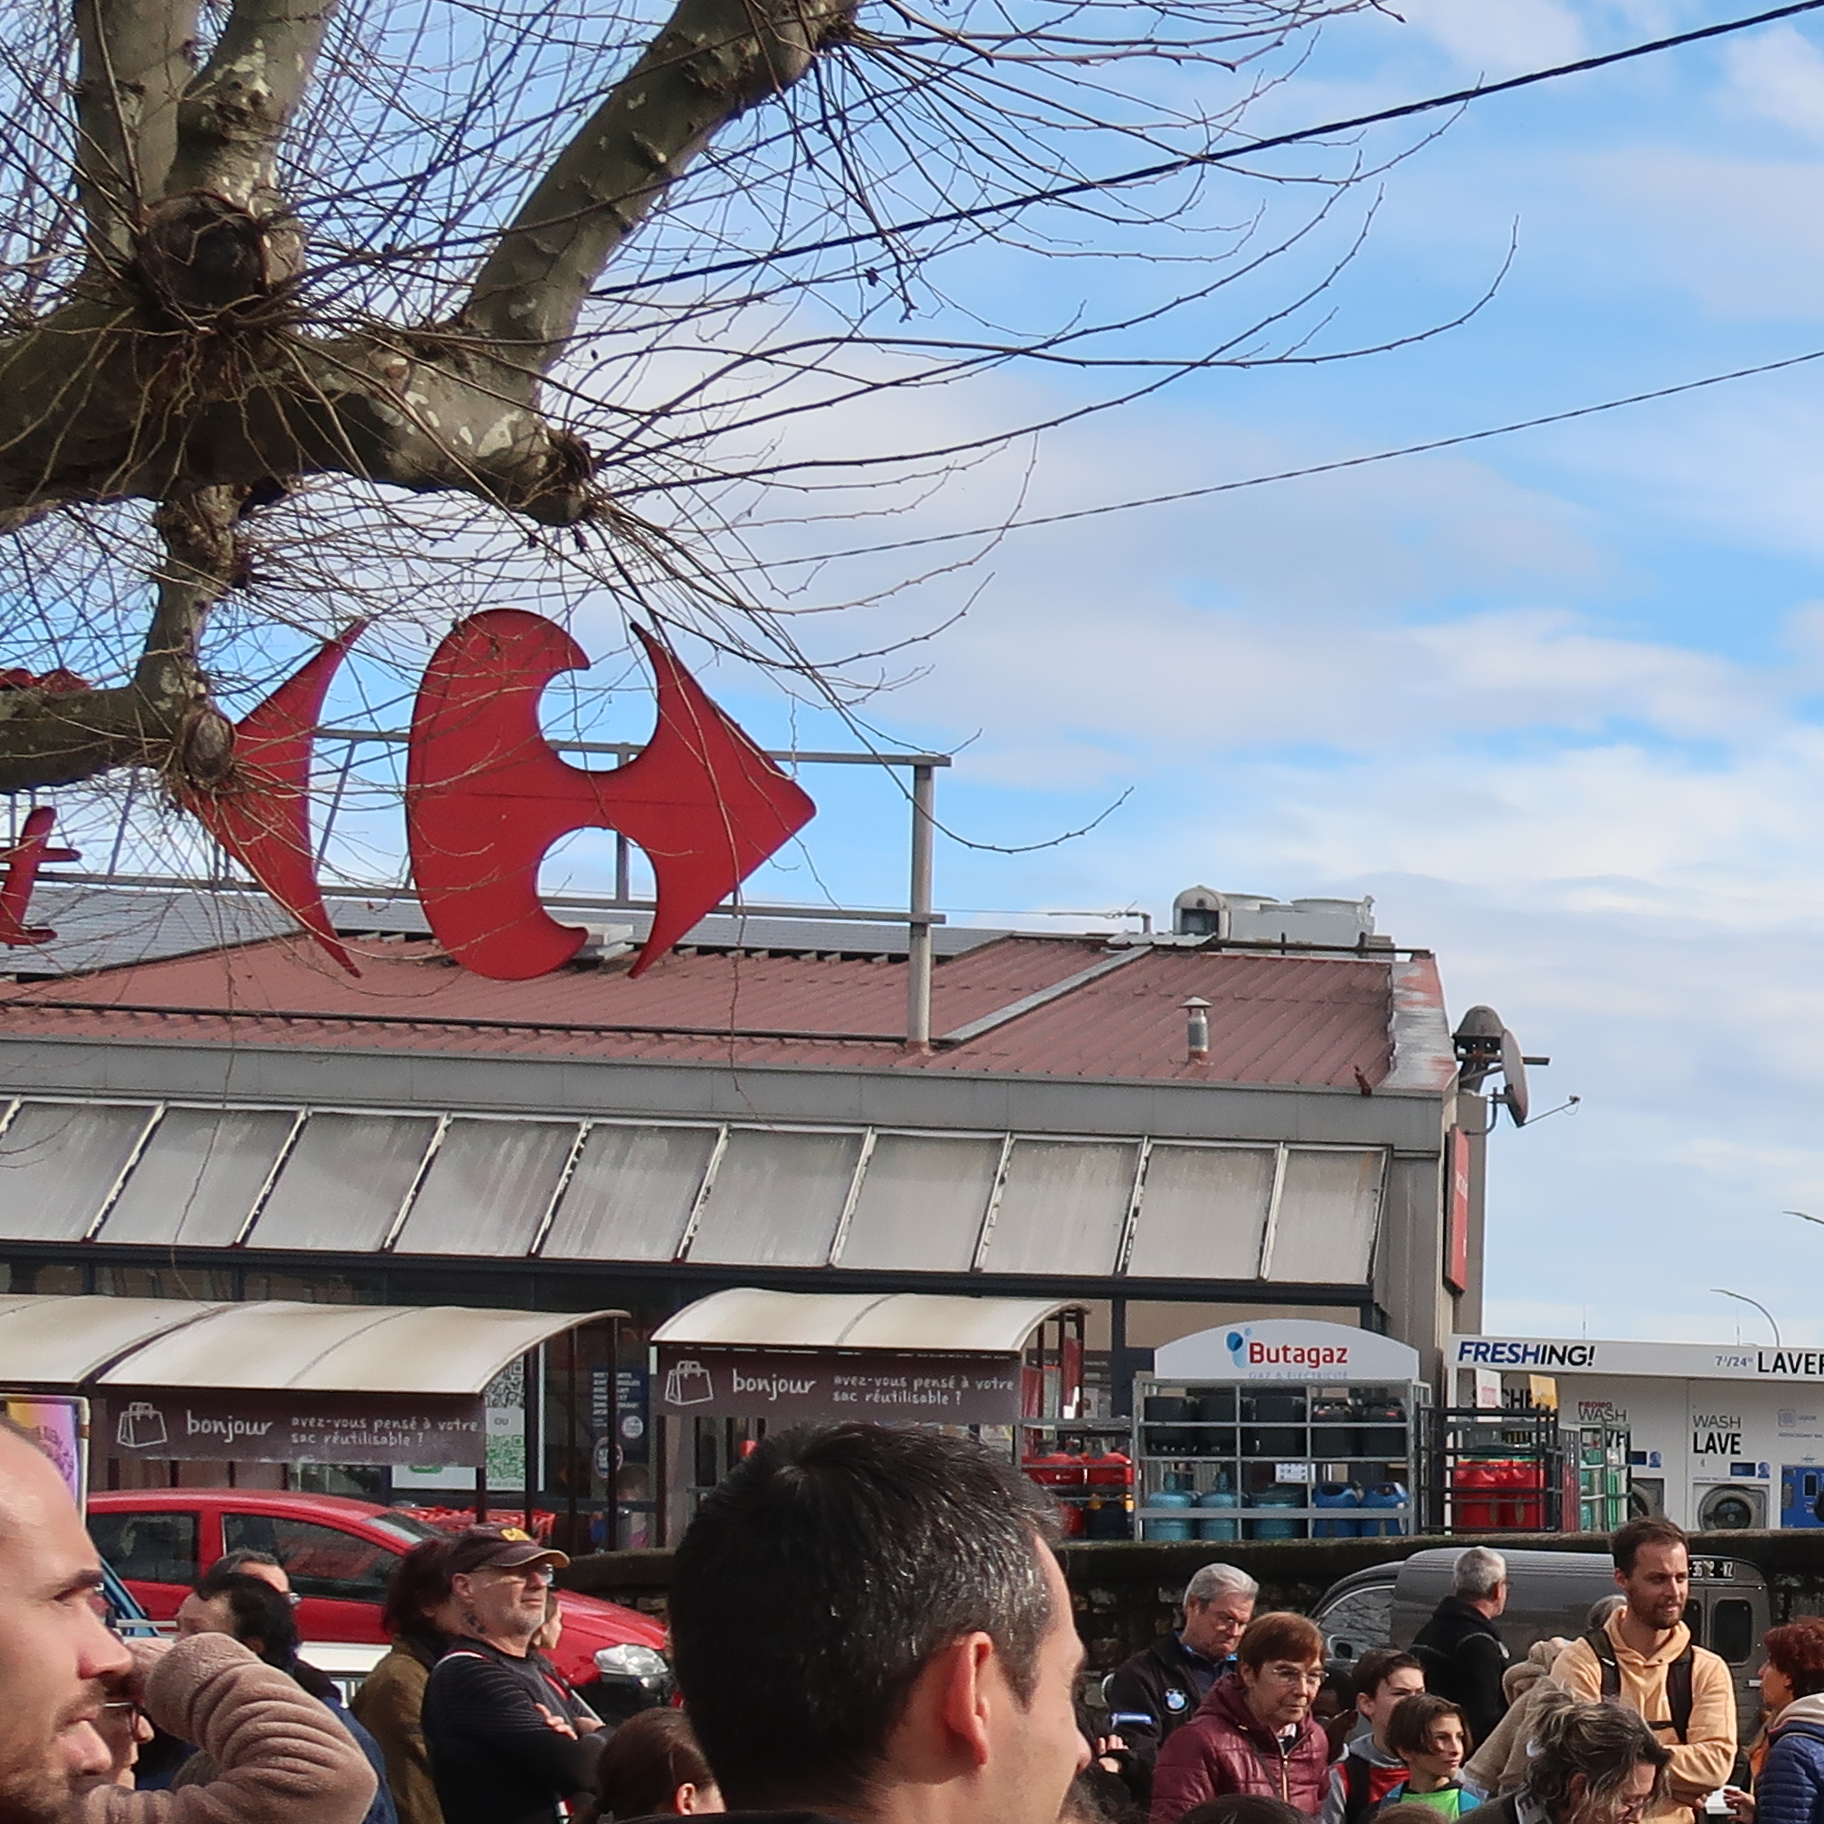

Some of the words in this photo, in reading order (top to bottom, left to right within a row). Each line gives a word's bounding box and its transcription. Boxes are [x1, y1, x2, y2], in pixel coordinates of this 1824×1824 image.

[1249, 1341, 1349, 1369] Butagaz
[1457, 1340, 1596, 1368] FRESHING!
[732, 1367, 818, 1402] bonjour
[833, 1375, 907, 1388] avez-vous
[913, 1375, 956, 1391] pensé
[975, 1378, 1015, 1391] votre
[832, 1390, 858, 1402] sac
[865, 1388, 950, 1405] réutilisable
[186, 1409, 274, 1443] bonjour
[291, 1416, 368, 1430] avez-vous
[373, 1415, 417, 1432] pensé
[437, 1418, 479, 1432] votre
[1578, 1407, 1627, 1422] WASH
[1692, 1415, 1742, 1429] WASH
[291, 1433, 316, 1444] sac
[1692, 1433, 1742, 1456] LAVE
